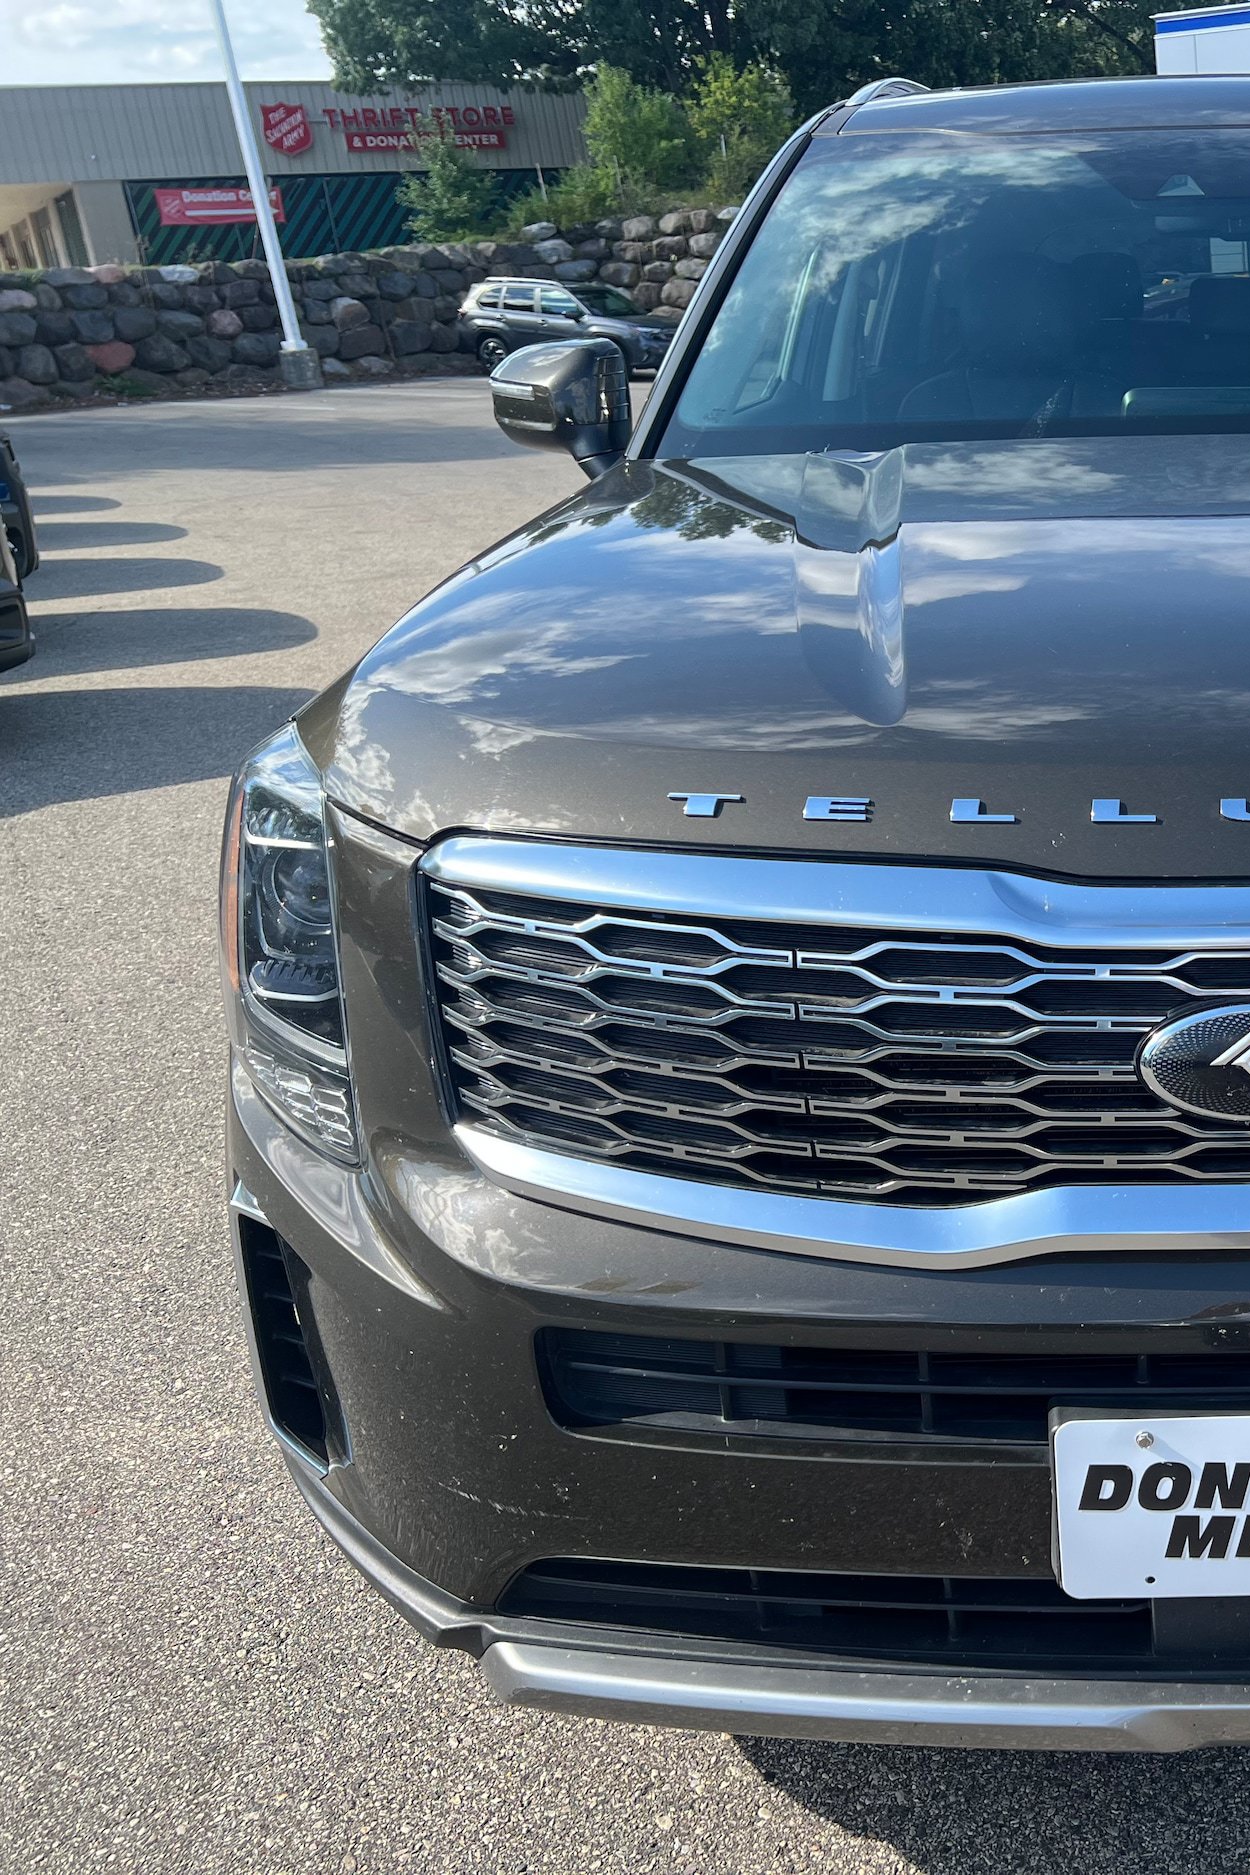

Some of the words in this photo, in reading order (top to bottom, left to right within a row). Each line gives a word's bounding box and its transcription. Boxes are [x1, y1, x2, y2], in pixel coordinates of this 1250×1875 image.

[265, 108, 303, 143] SALVATION
[268, 106, 287, 125] THE
[322, 107, 418, 129] THRIFT
[282, 123, 305, 149] ARMY
[352, 135, 363, 148] &
[452, 133, 500, 146] ENTER
[182, 190, 237, 203] Donation
